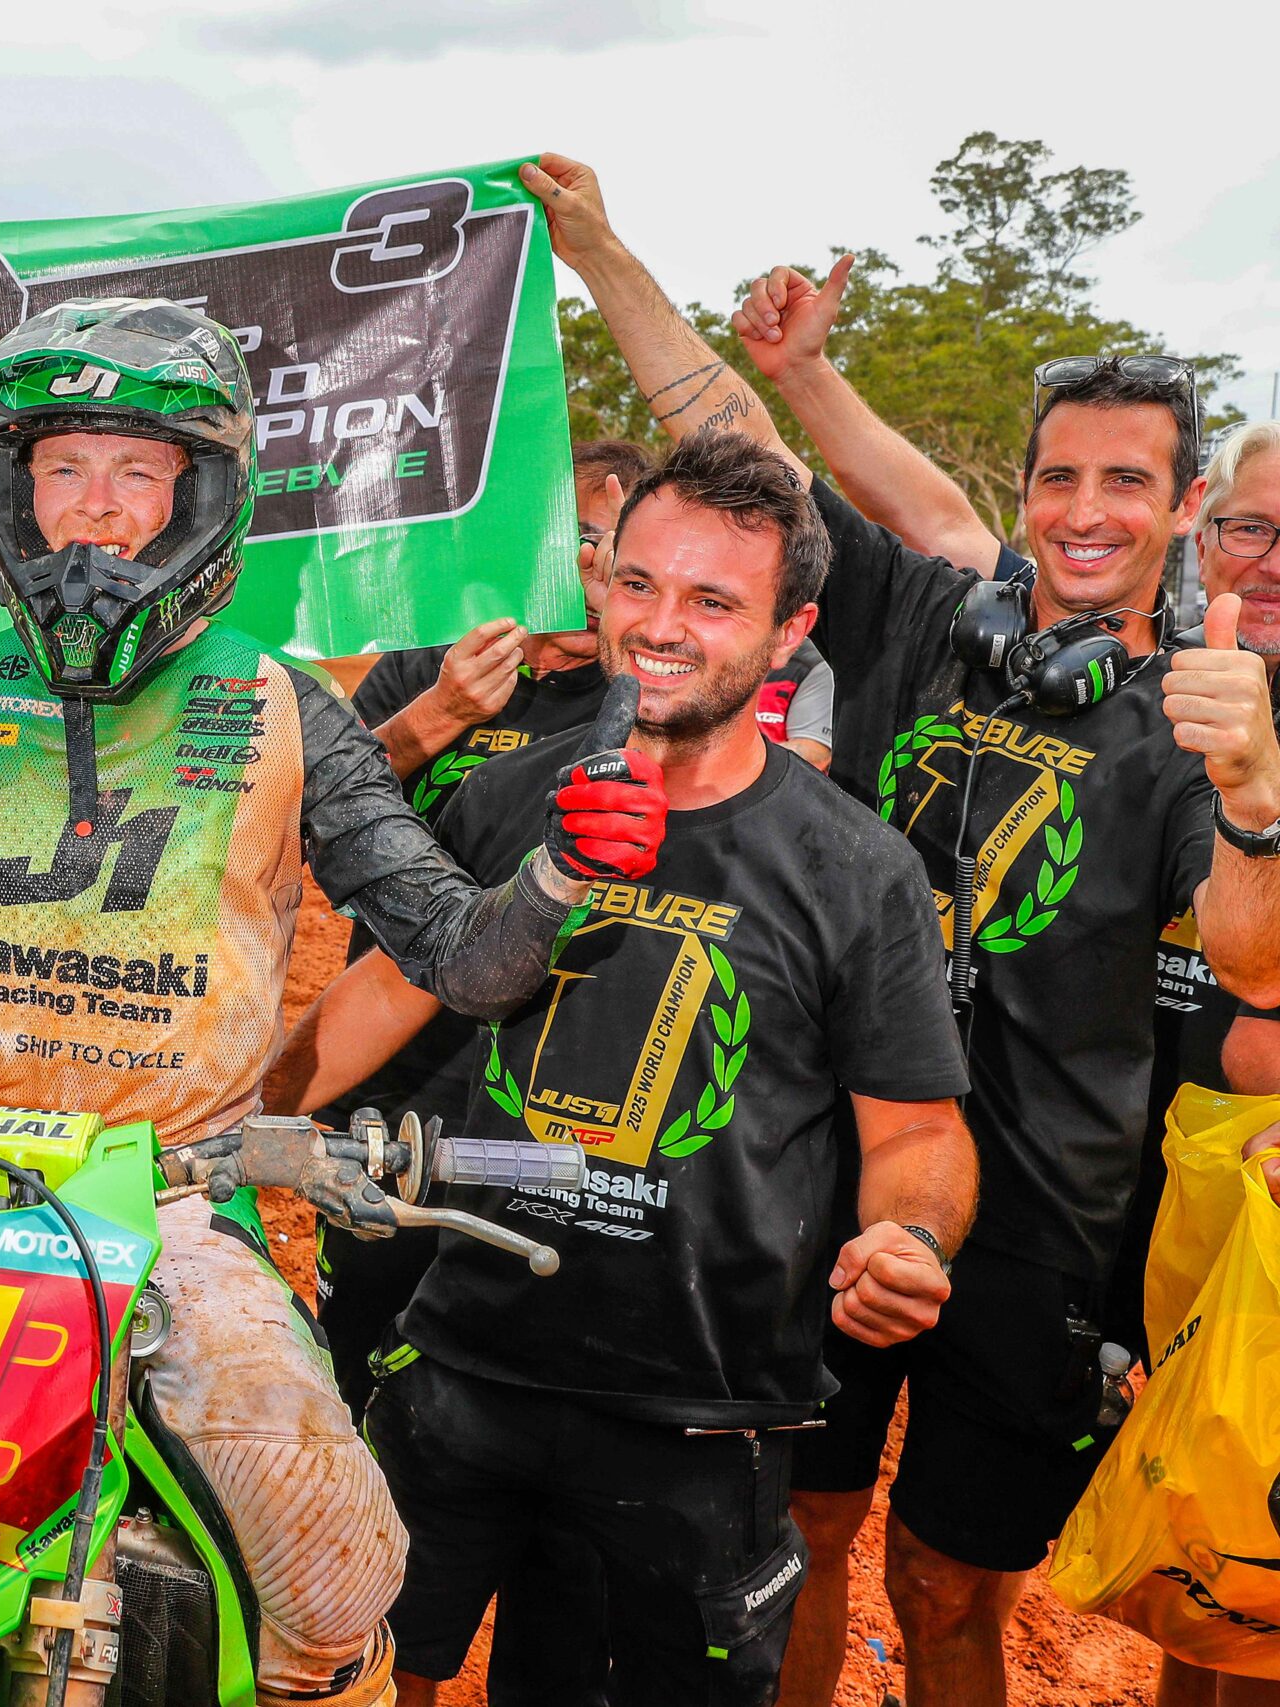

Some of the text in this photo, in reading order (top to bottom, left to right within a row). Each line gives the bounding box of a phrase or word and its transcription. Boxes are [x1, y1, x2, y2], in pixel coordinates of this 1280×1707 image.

[994, 786, 1048, 850] CHAMPION
[82, 990, 172, 1024] Team
[15, 1034, 185, 1070] SHIP TO CYCLE
[626, 953, 699, 1133] 2025 WORLD CHAMPION
[530, 1089, 621, 1123] JUST1
[545, 1121, 616, 1145] MXGP
[585, 1194, 644, 1221] Team
[574, 1220, 654, 1241] 450
[744, 1553, 802, 1612] Kawasaki
